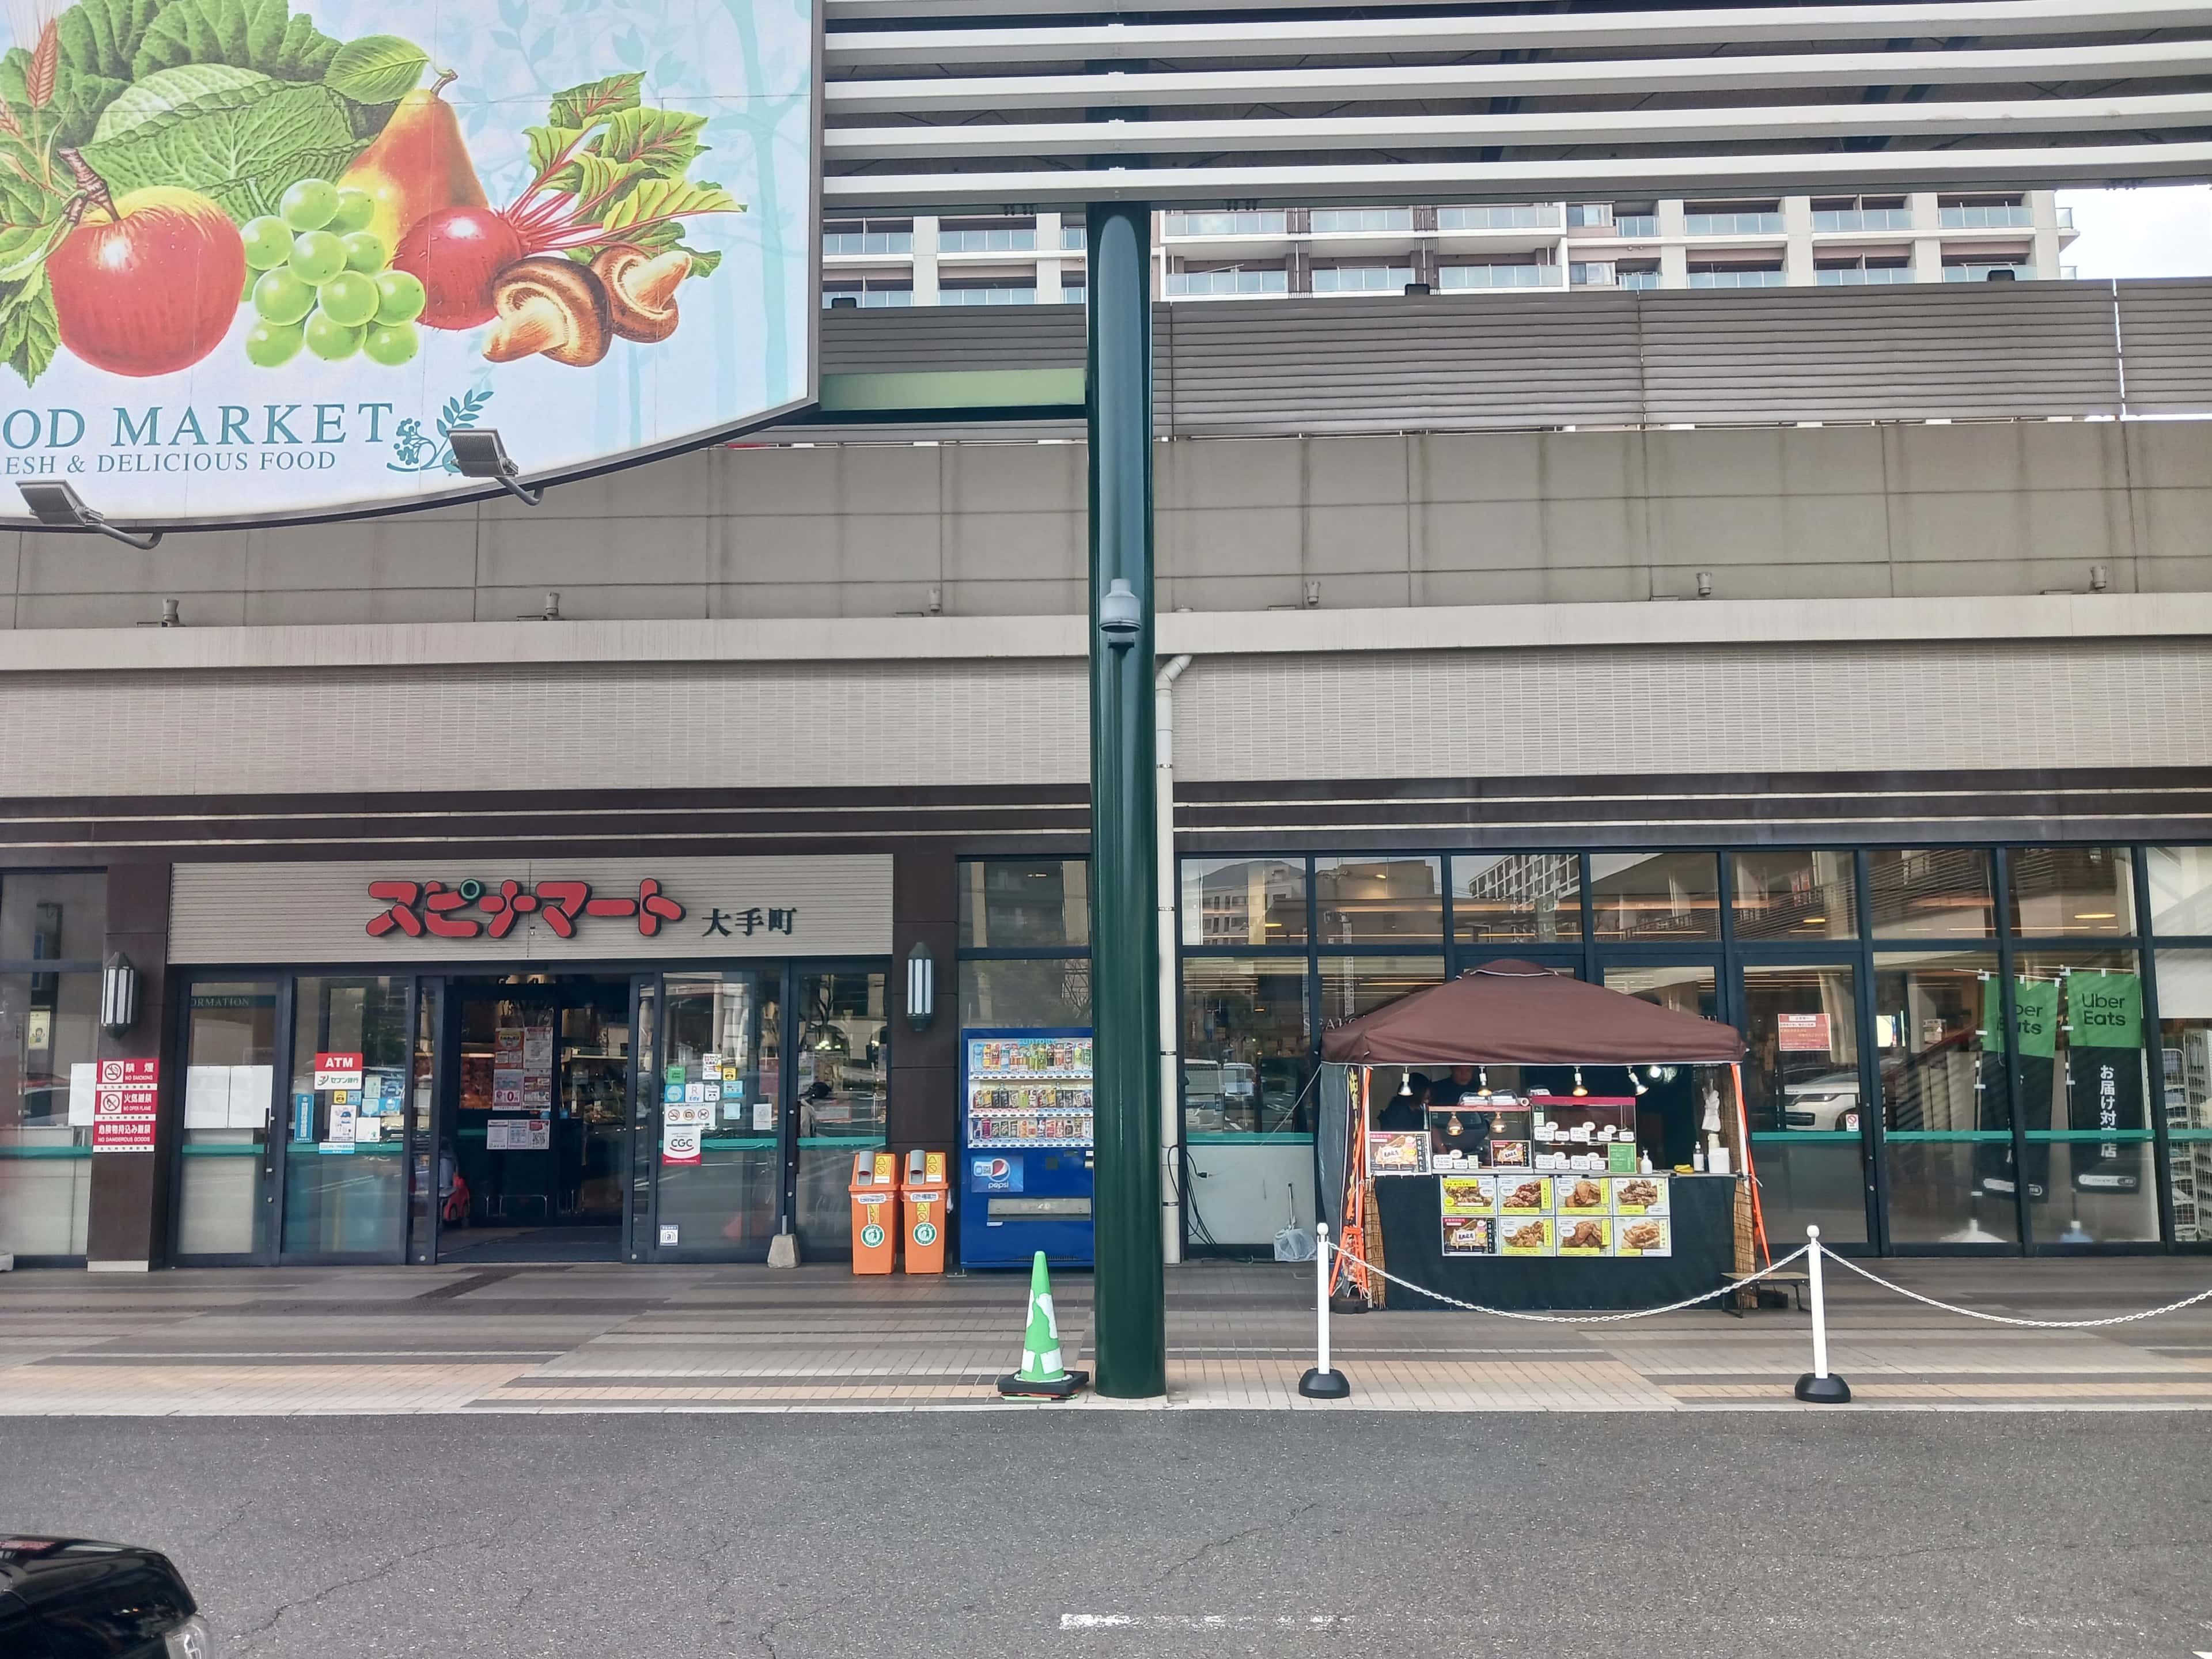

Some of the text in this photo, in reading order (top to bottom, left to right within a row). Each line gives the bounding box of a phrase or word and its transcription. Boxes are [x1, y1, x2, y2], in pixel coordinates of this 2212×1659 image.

[112, 403, 393, 446] MARKET
[0, 450, 336, 475] ESH & DELICIOUS FOOD
[365, 877, 797, 939] スピナマート 大手町
[2082, 993, 2126, 1009] Uber
[1997, 1017, 2043, 1035] Ets
[2084, 1010, 2126, 1026] Eats
[325, 1057, 354, 1068] ATM
[2100, 1065, 2117, 1158] お届け対店
[671, 1138, 693, 1147] CGC
